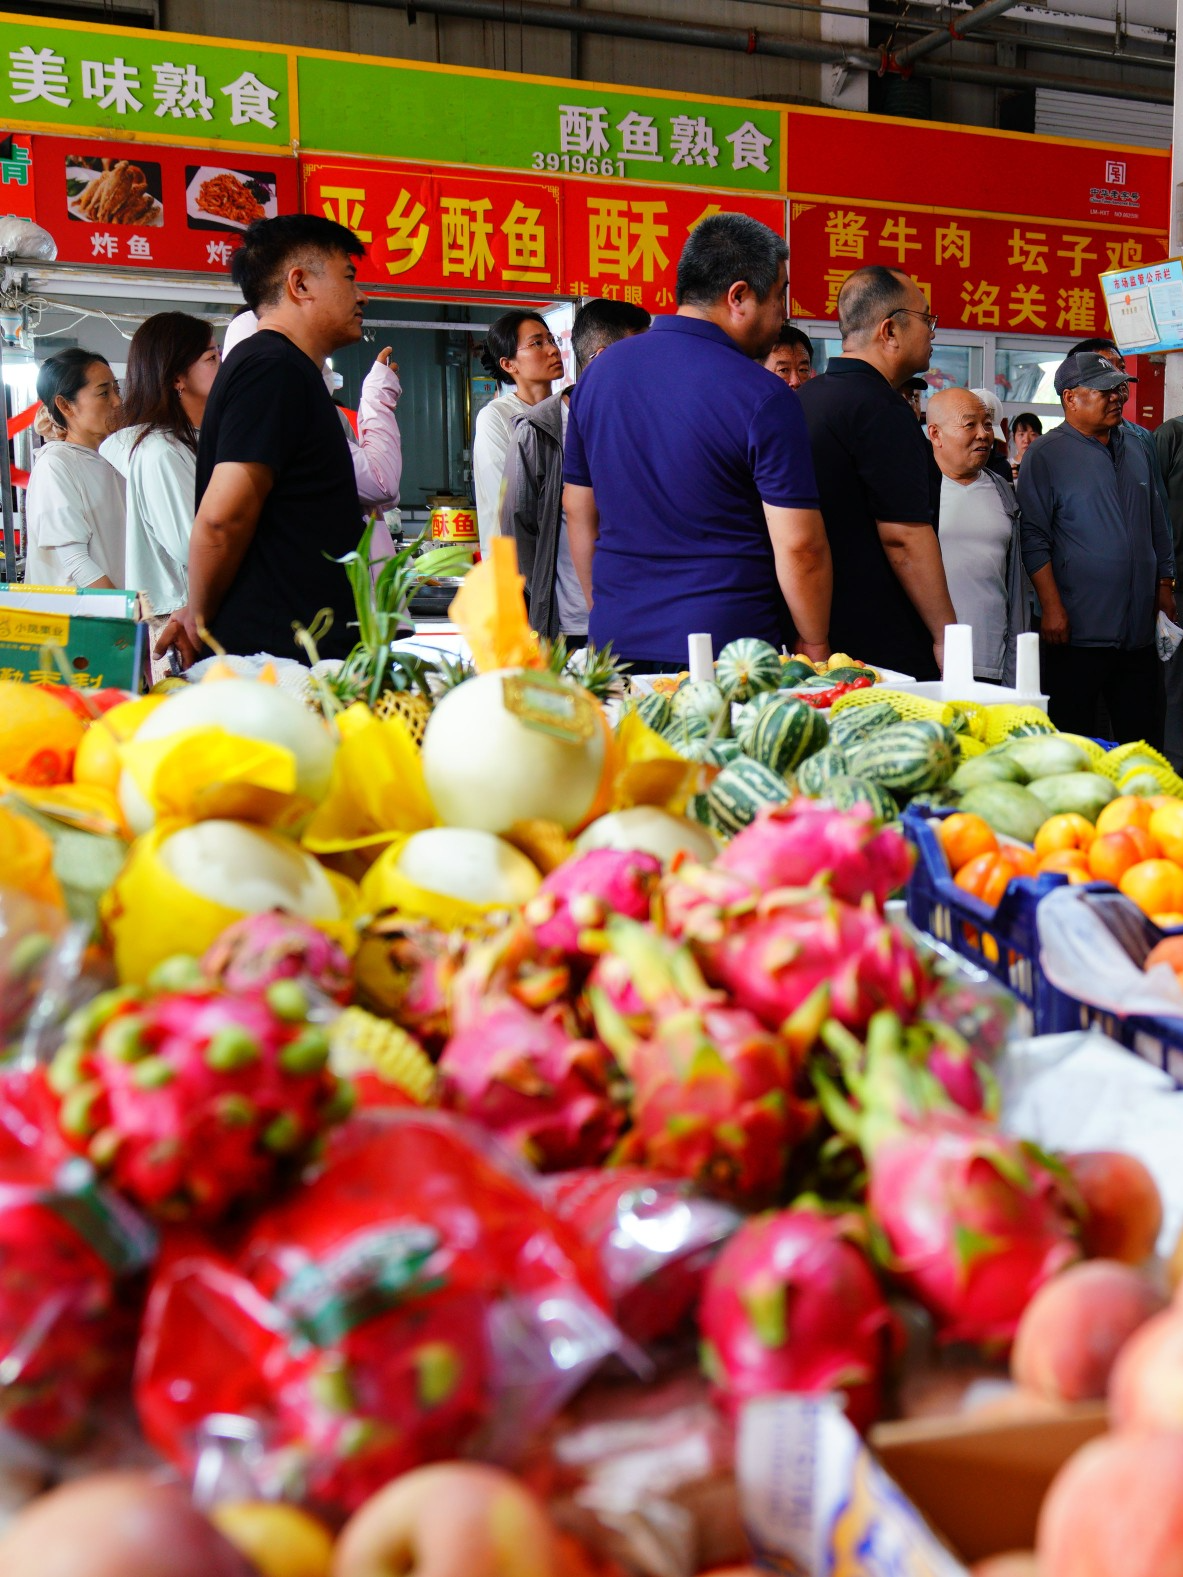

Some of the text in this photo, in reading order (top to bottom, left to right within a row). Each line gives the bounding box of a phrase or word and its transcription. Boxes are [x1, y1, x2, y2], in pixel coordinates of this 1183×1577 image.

[9, 46, 279, 129] 美味熟食
[558, 104, 773, 174] 酥鱼熟食
[531, 151, 626, 178] 3919661
[90, 232, 153, 261] 炸鱼
[319, 185, 551, 283] 平乡酥鱼
[824, 210, 1143, 278] 酱牛肉 坛子鸡
[1113, 268, 1172, 289] 市场监管公示栏
[432, 512, 477, 538] 酥鱼
